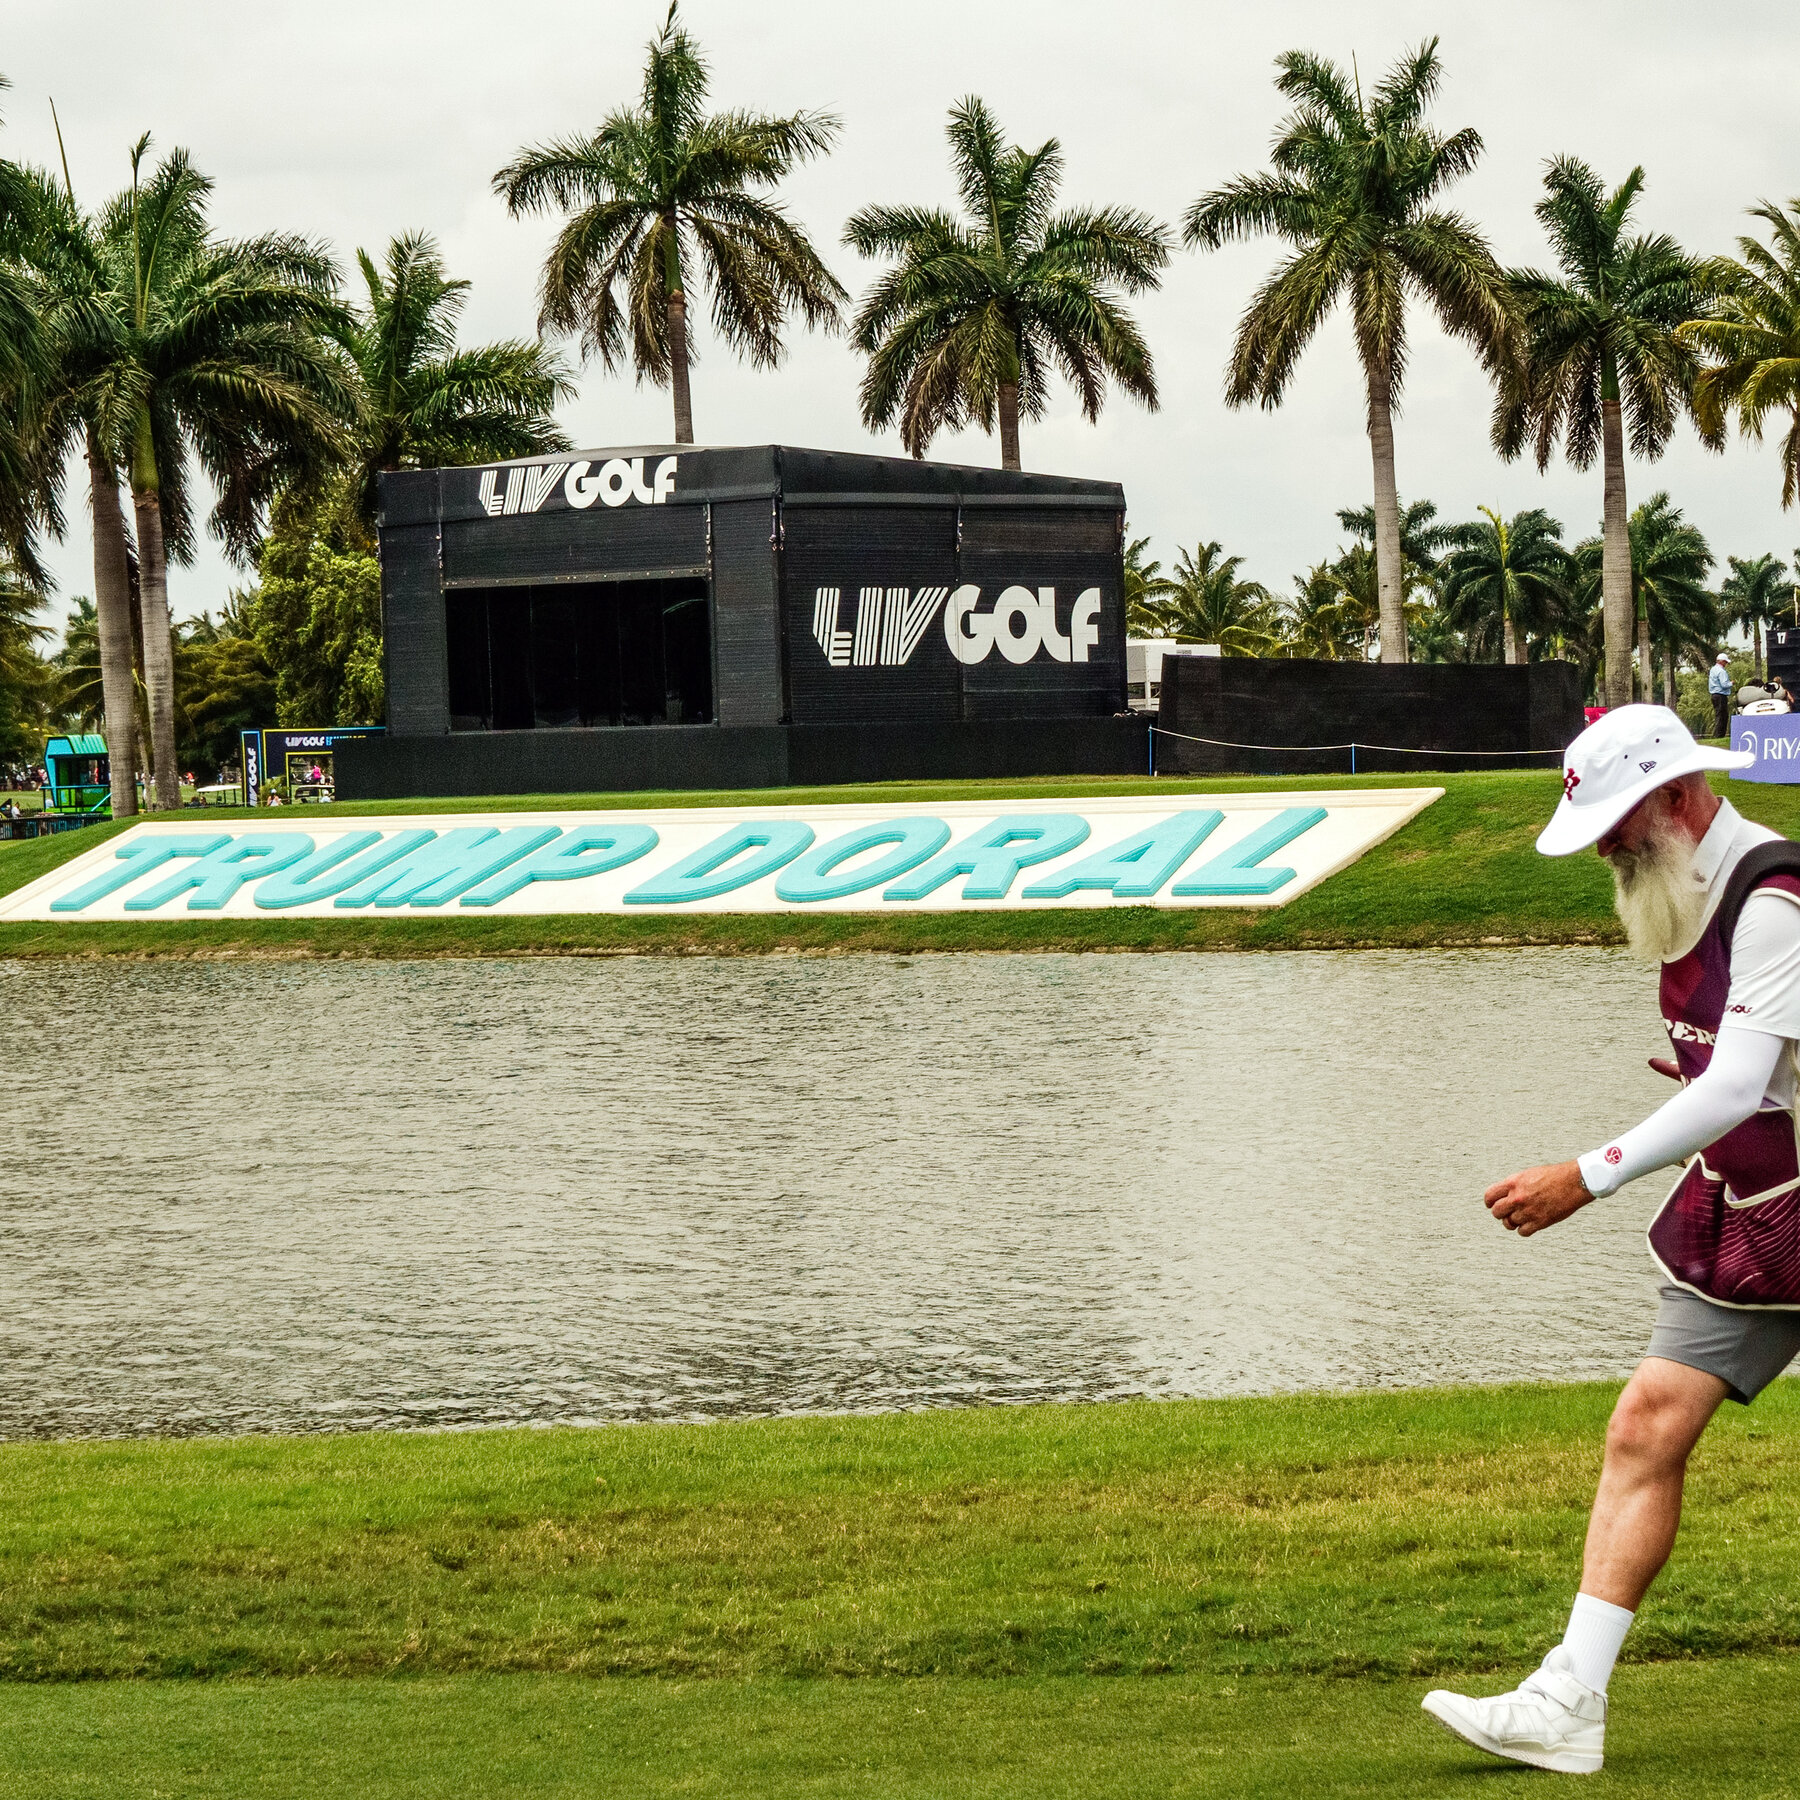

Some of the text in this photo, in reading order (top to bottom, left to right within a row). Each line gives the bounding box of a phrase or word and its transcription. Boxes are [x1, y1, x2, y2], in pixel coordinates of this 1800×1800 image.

[479, 456, 678, 516] LIV GOLF
[812, 584, 1101, 666] LIV GOLF
[1776, 632, 1787, 646] 17
[302, 736, 325, 747] GOLF
[50, 807, 1329, 912] TRUMP DORAL
